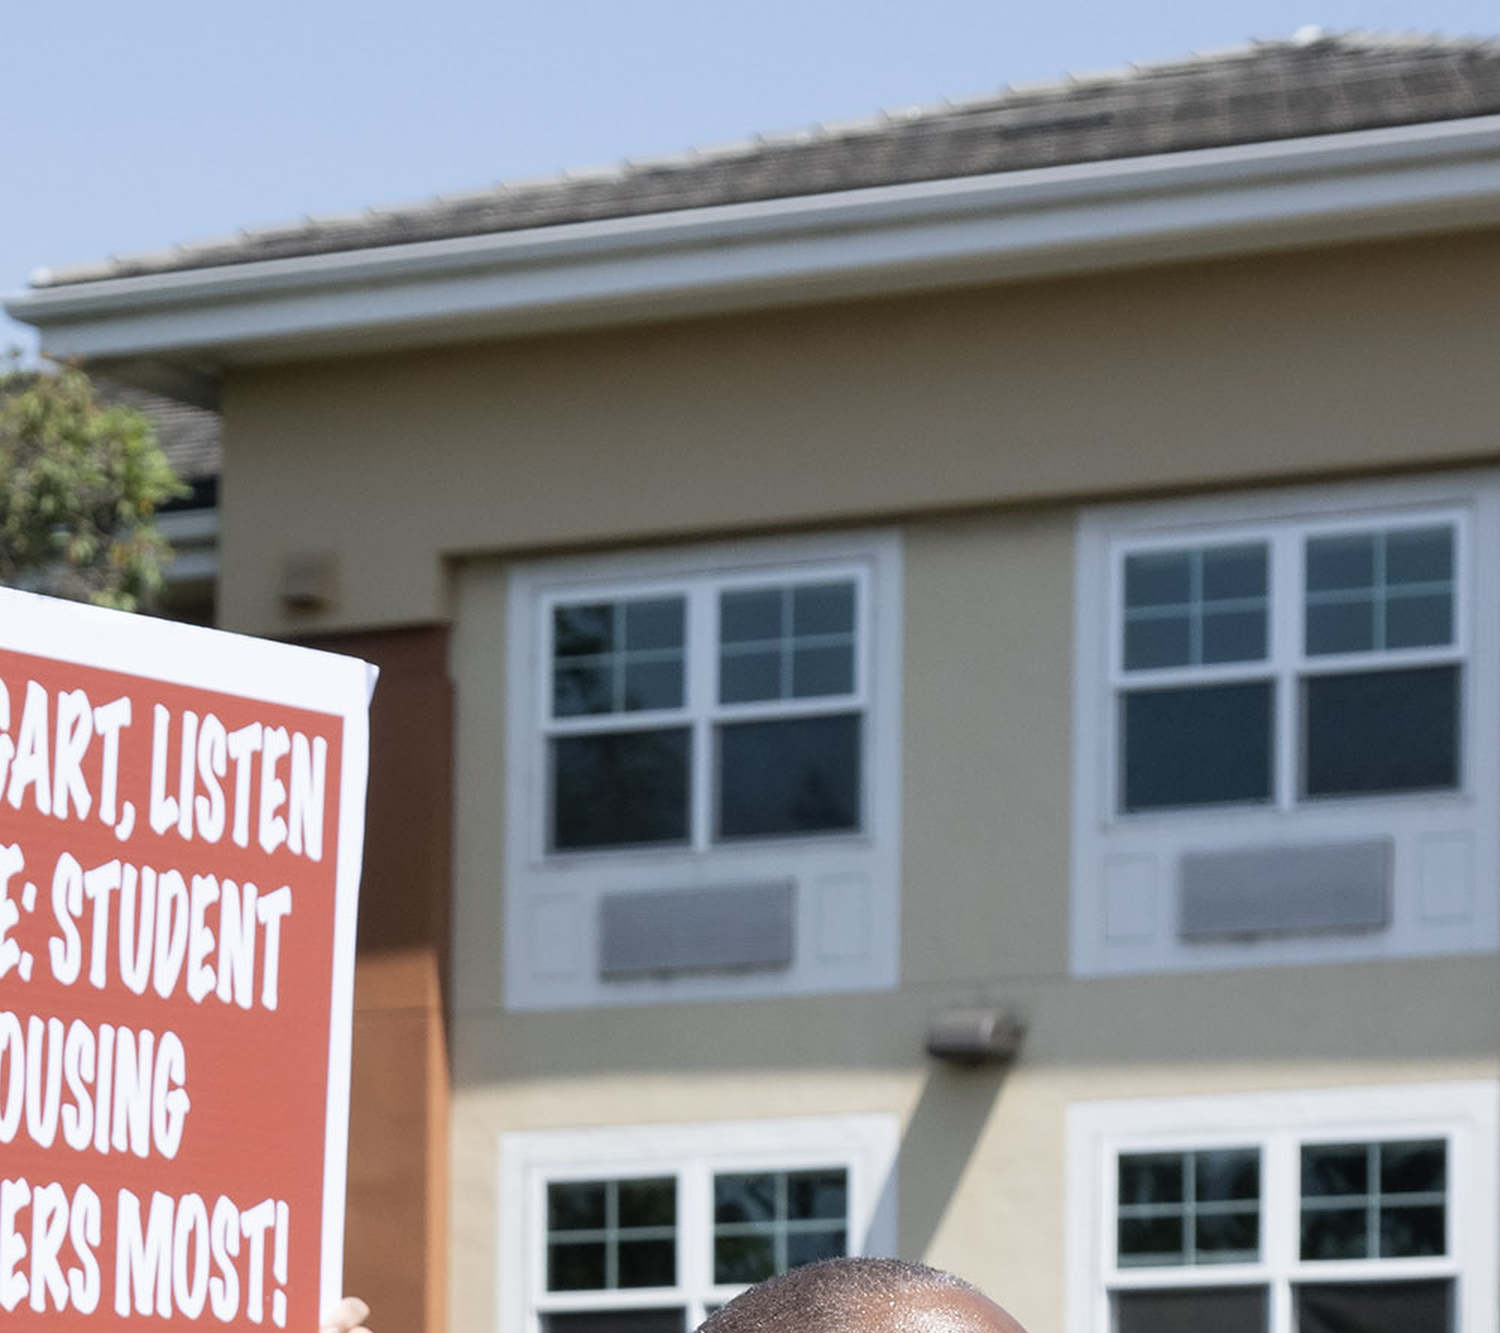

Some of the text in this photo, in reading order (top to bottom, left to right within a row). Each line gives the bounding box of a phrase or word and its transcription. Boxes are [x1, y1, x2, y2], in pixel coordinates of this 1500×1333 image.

[149, 704, 327, 861] LISTEN
[48, 852, 292, 1011] STUDENT
[114, 1188, 289, 1328] MOST!
